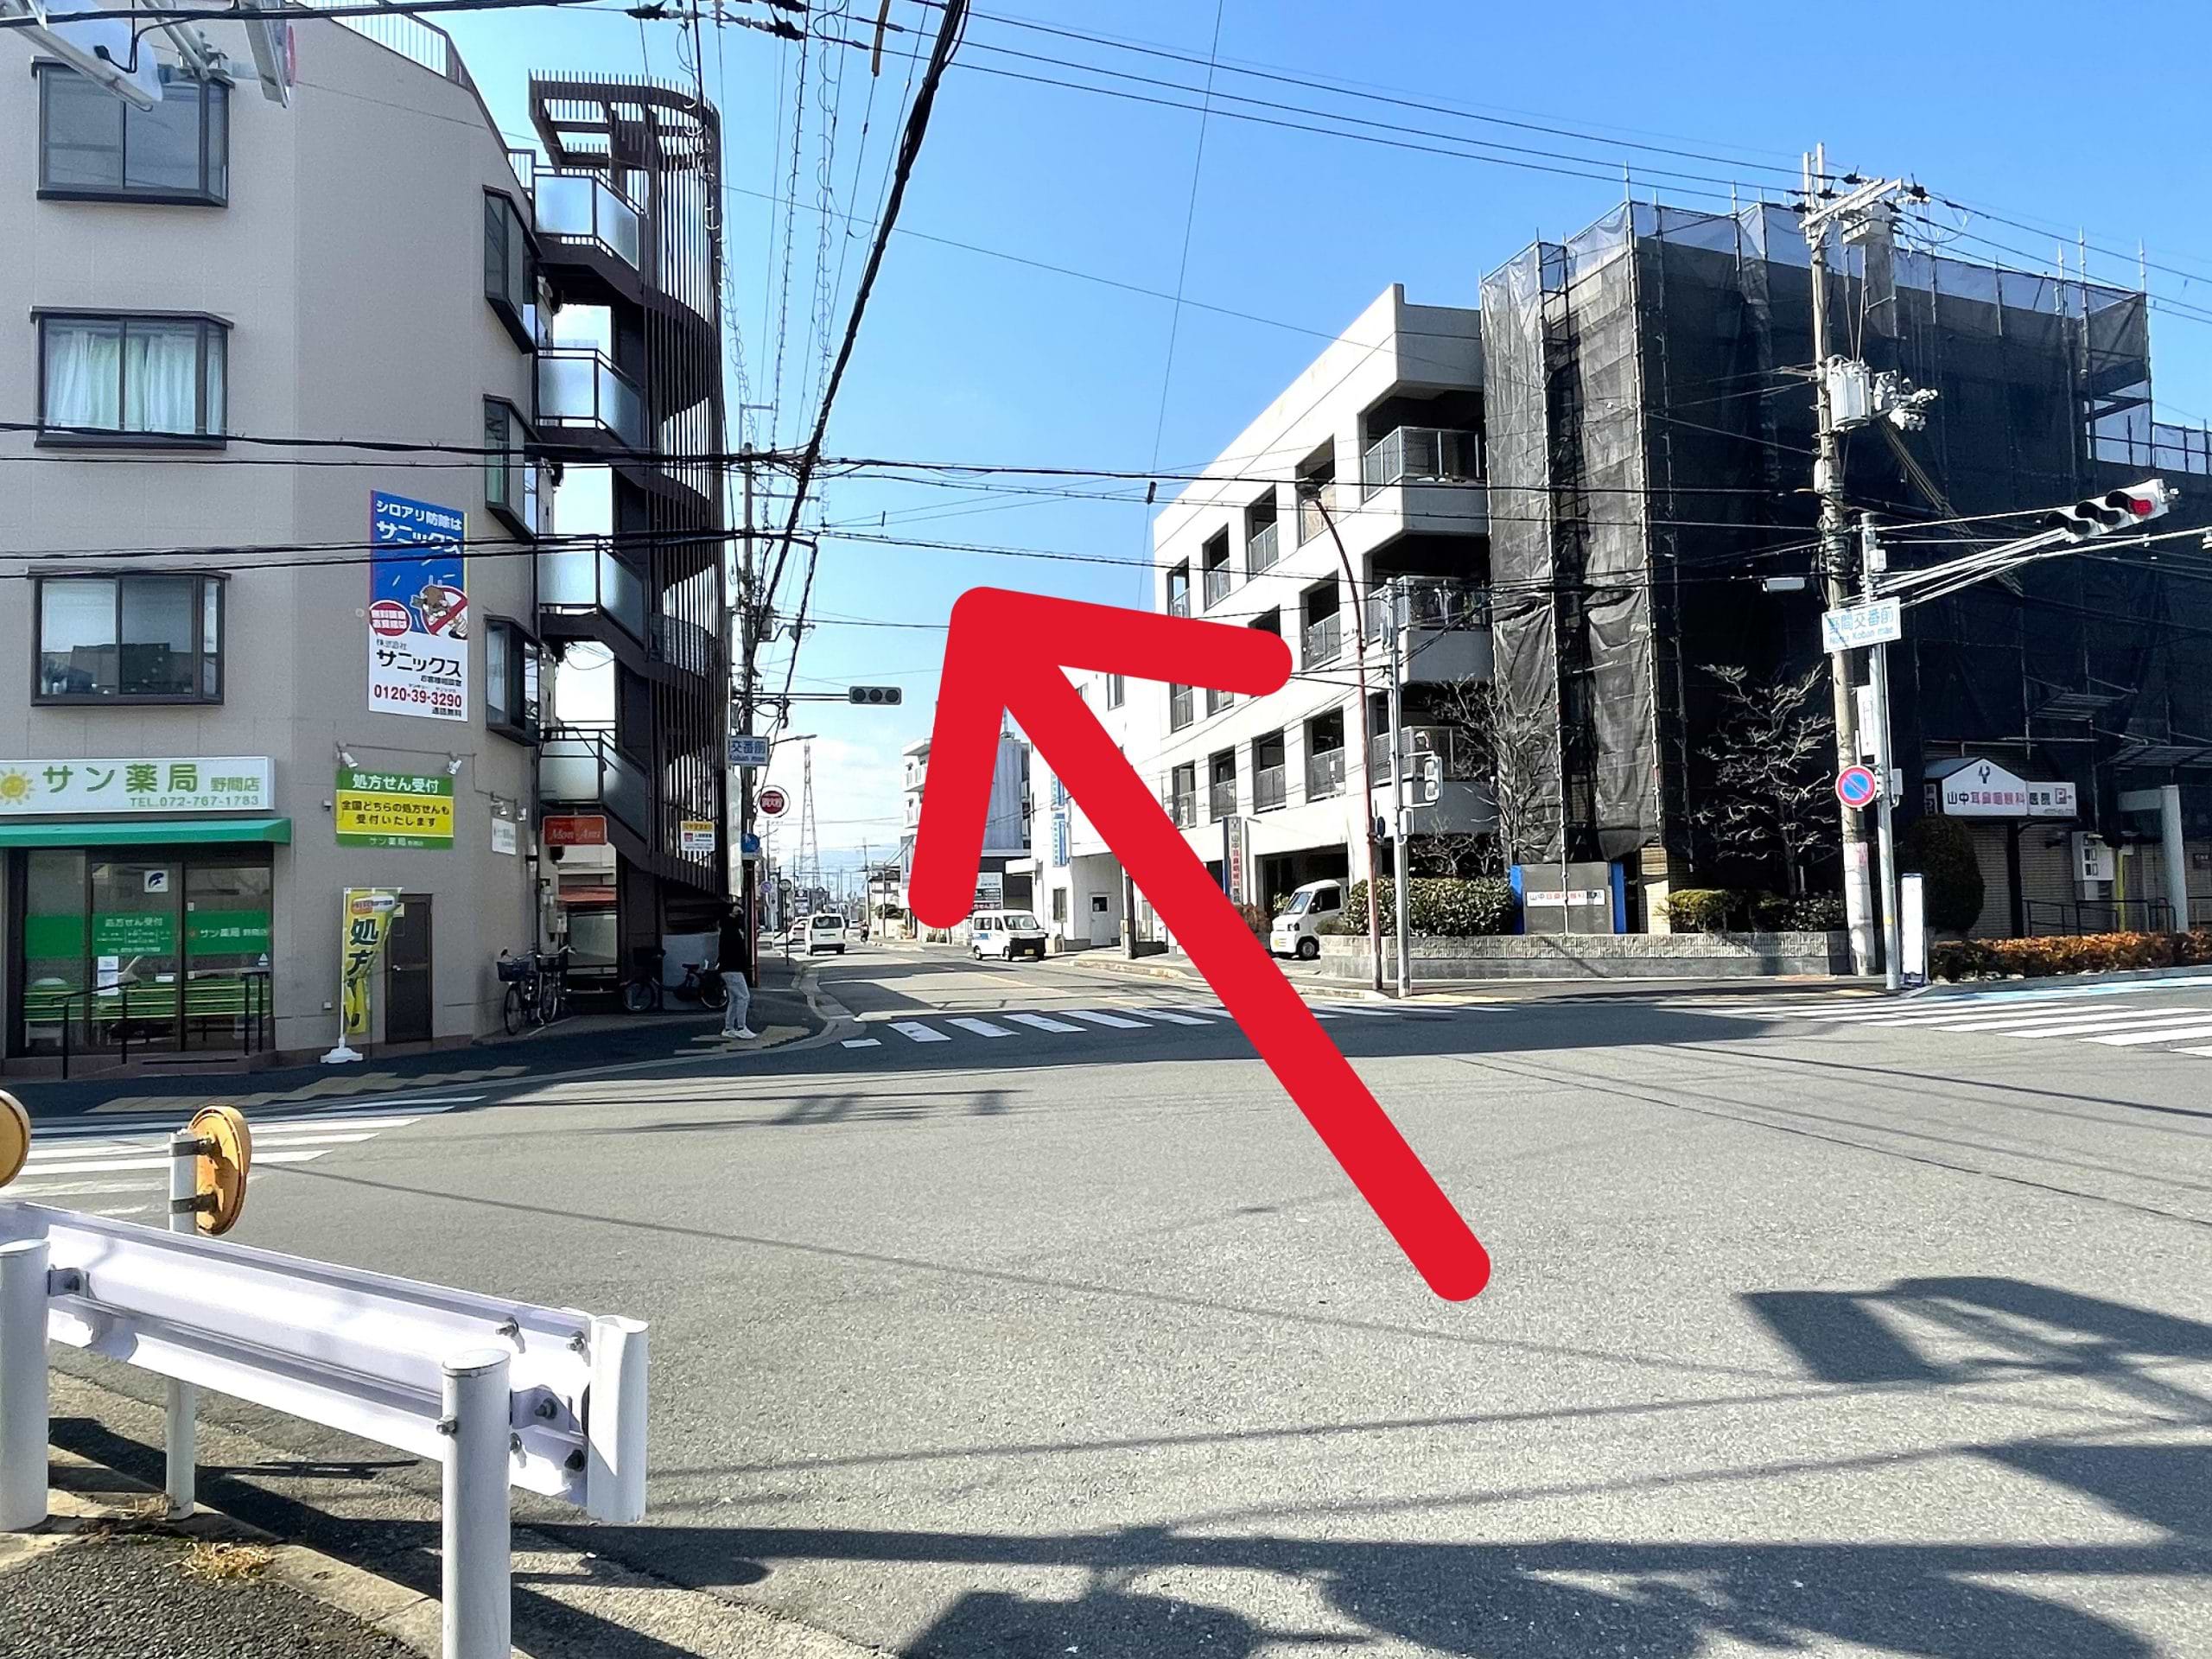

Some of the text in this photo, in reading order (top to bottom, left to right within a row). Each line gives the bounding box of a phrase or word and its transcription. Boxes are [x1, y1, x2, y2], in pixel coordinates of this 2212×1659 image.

[376, 500, 462, 531] シロアリ防除は
[377, 649, 461, 677] サニックス
[42, 763, 260, 793] サン薬局 野間店
[353, 774, 439, 793] 処方せん受付
[342, 800, 449, 815] 全国どちらの処方せんも
[356, 814, 435, 827] 受付いたします
